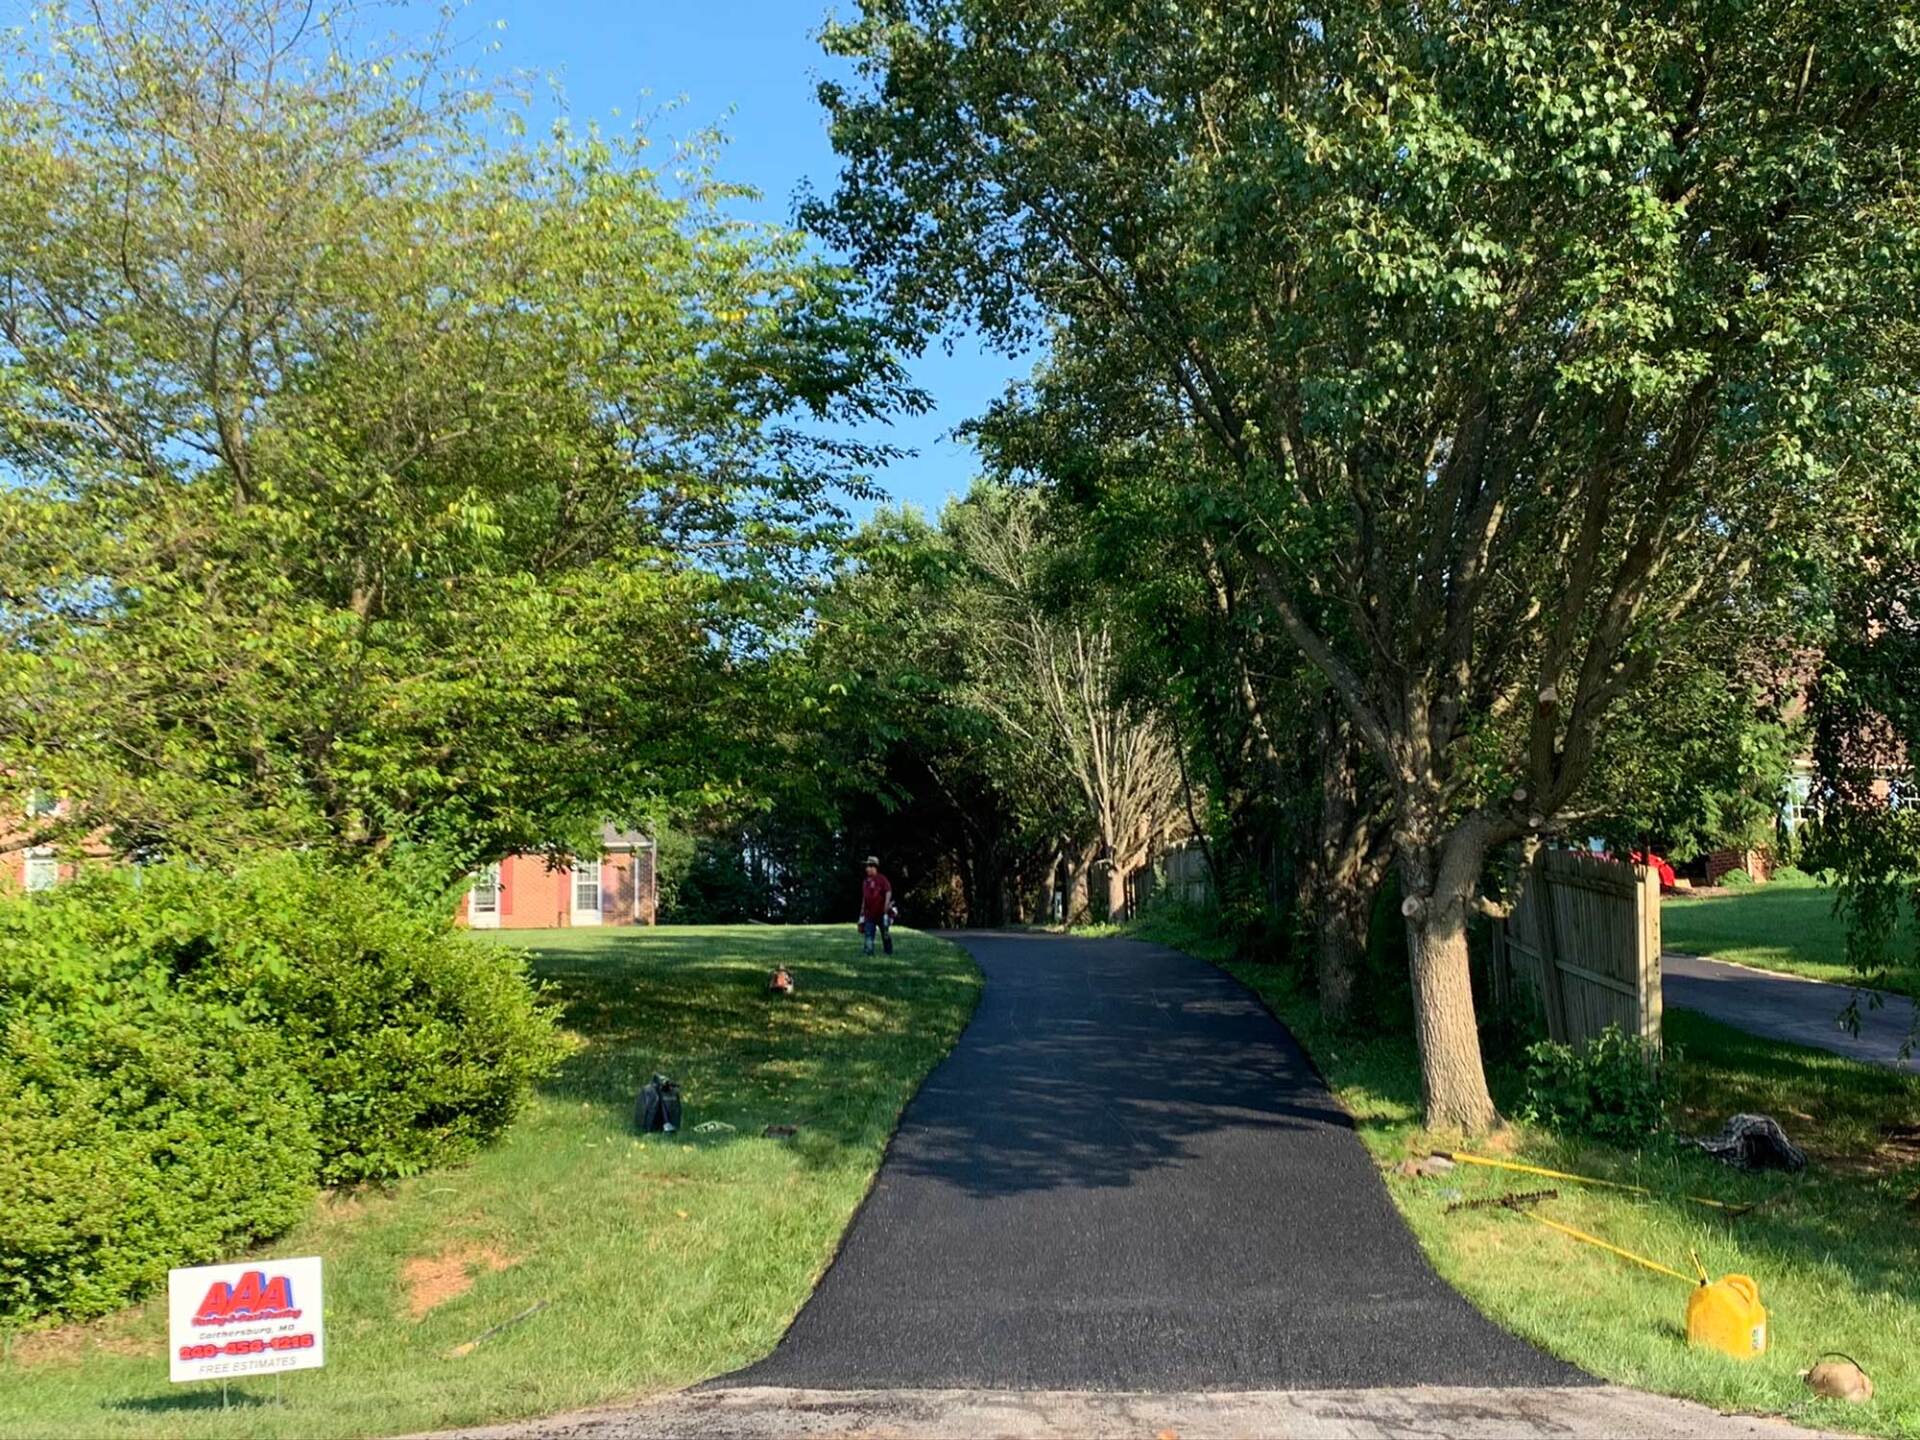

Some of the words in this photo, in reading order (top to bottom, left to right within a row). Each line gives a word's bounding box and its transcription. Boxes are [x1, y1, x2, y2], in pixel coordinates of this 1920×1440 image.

[194, 1271, 294, 1317] AAA
[199, 1362, 230, 1374] FREE
[232, 1356, 297, 1372] ESTIMATES
